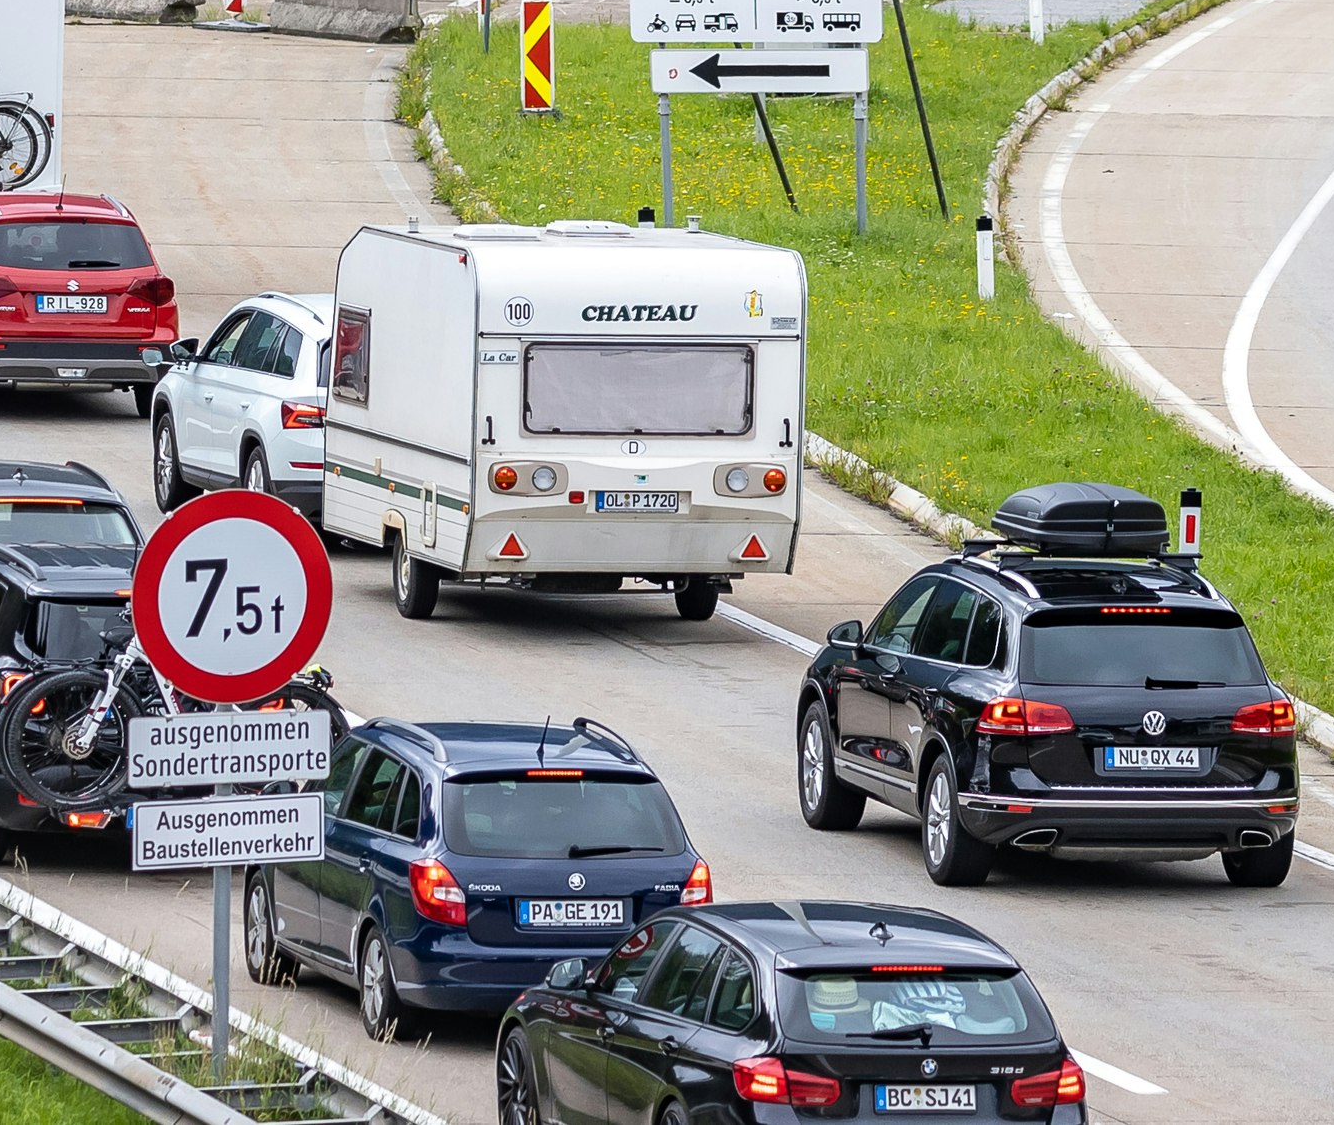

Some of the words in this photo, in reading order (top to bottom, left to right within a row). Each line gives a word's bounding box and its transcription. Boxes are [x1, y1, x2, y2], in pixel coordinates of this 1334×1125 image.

[46, 297, 104, 310] RIL-928
[507, 303, 531, 320] 100
[581, 304, 700, 322] CHATEAU
[483, 353, 496, 361] La
[499, 353, 516, 361] Car
[629, 441, 639, 454] D
[606, 492, 623, 507] OL
[632, 493, 641, 506] P
[644, 492, 676, 507] 1720
[150, 720, 310, 749] ausgenommen
[132, 749, 327, 777] Sondertransporte
[1119, 750, 1139, 765] NU
[1151, 750, 1170, 765] QX
[1176, 750, 1194, 765] 44
[156, 807, 299, 833] Ausgenommen
[142, 832, 315, 860] Baustellenverkehr
[468, 883, 502, 891] ŠKODA
[532, 903, 553, 920] PA
[565, 903, 586, 920] GE
[590, 903, 621, 920] 191
[888, 1088, 912, 1107] BC
[925, 1088, 949, 1107] SJ
[952, 1088, 973, 1107] 41
